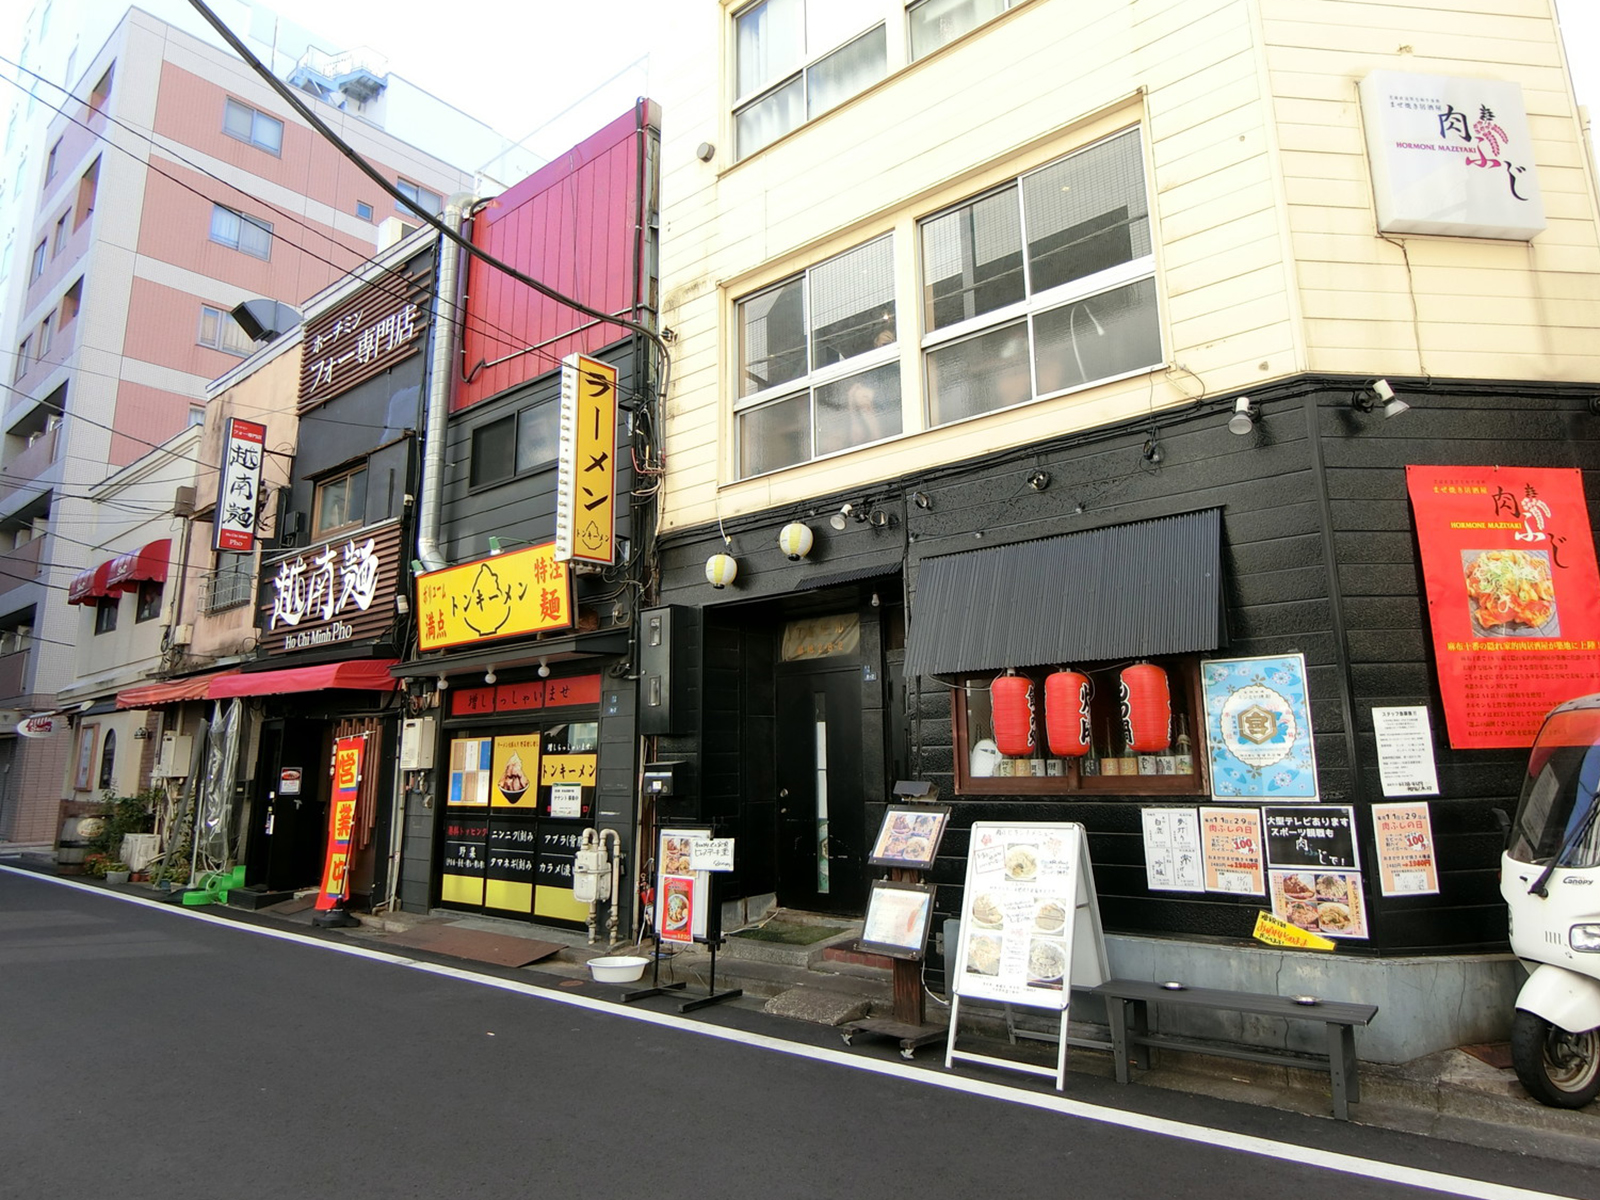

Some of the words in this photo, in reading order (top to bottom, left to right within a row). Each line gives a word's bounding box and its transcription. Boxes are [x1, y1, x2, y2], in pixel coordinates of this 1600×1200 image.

[1396, 142, 1436, 151] HORMONE
[1437, 144, 1477, 154] MAZEYAKI
[313, 310, 364, 354] ホーチミン
[310, 305, 418, 393] フォー専門店
[582, 372, 610, 512] ラーメン
[1450, 521, 1486, 530] HORMONE
[1487, 522, 1522, 530] MAZEYAKI
[229, 539, 243, 547] Pho
[534, 556, 563, 584] 特注
[451, 581, 528, 617] トンキーメン
[539, 588, 562, 622] 麺
[285, 635, 296, 650] Ho
[297, 631, 310, 647] Chi
[310, 628, 332, 645] Minh
[332, 620, 353, 642] Pho
[425, 609, 447, 641] 満点
[468, 685, 570, 710] 増しっしゃいませ
[542, 763, 596, 779] トンキーメン
[332, 752, 356, 890] 営業中
[1266, 816, 1349, 828] 大型テレビあります
[1271, 827, 1334, 839] スポーツ観戦も
